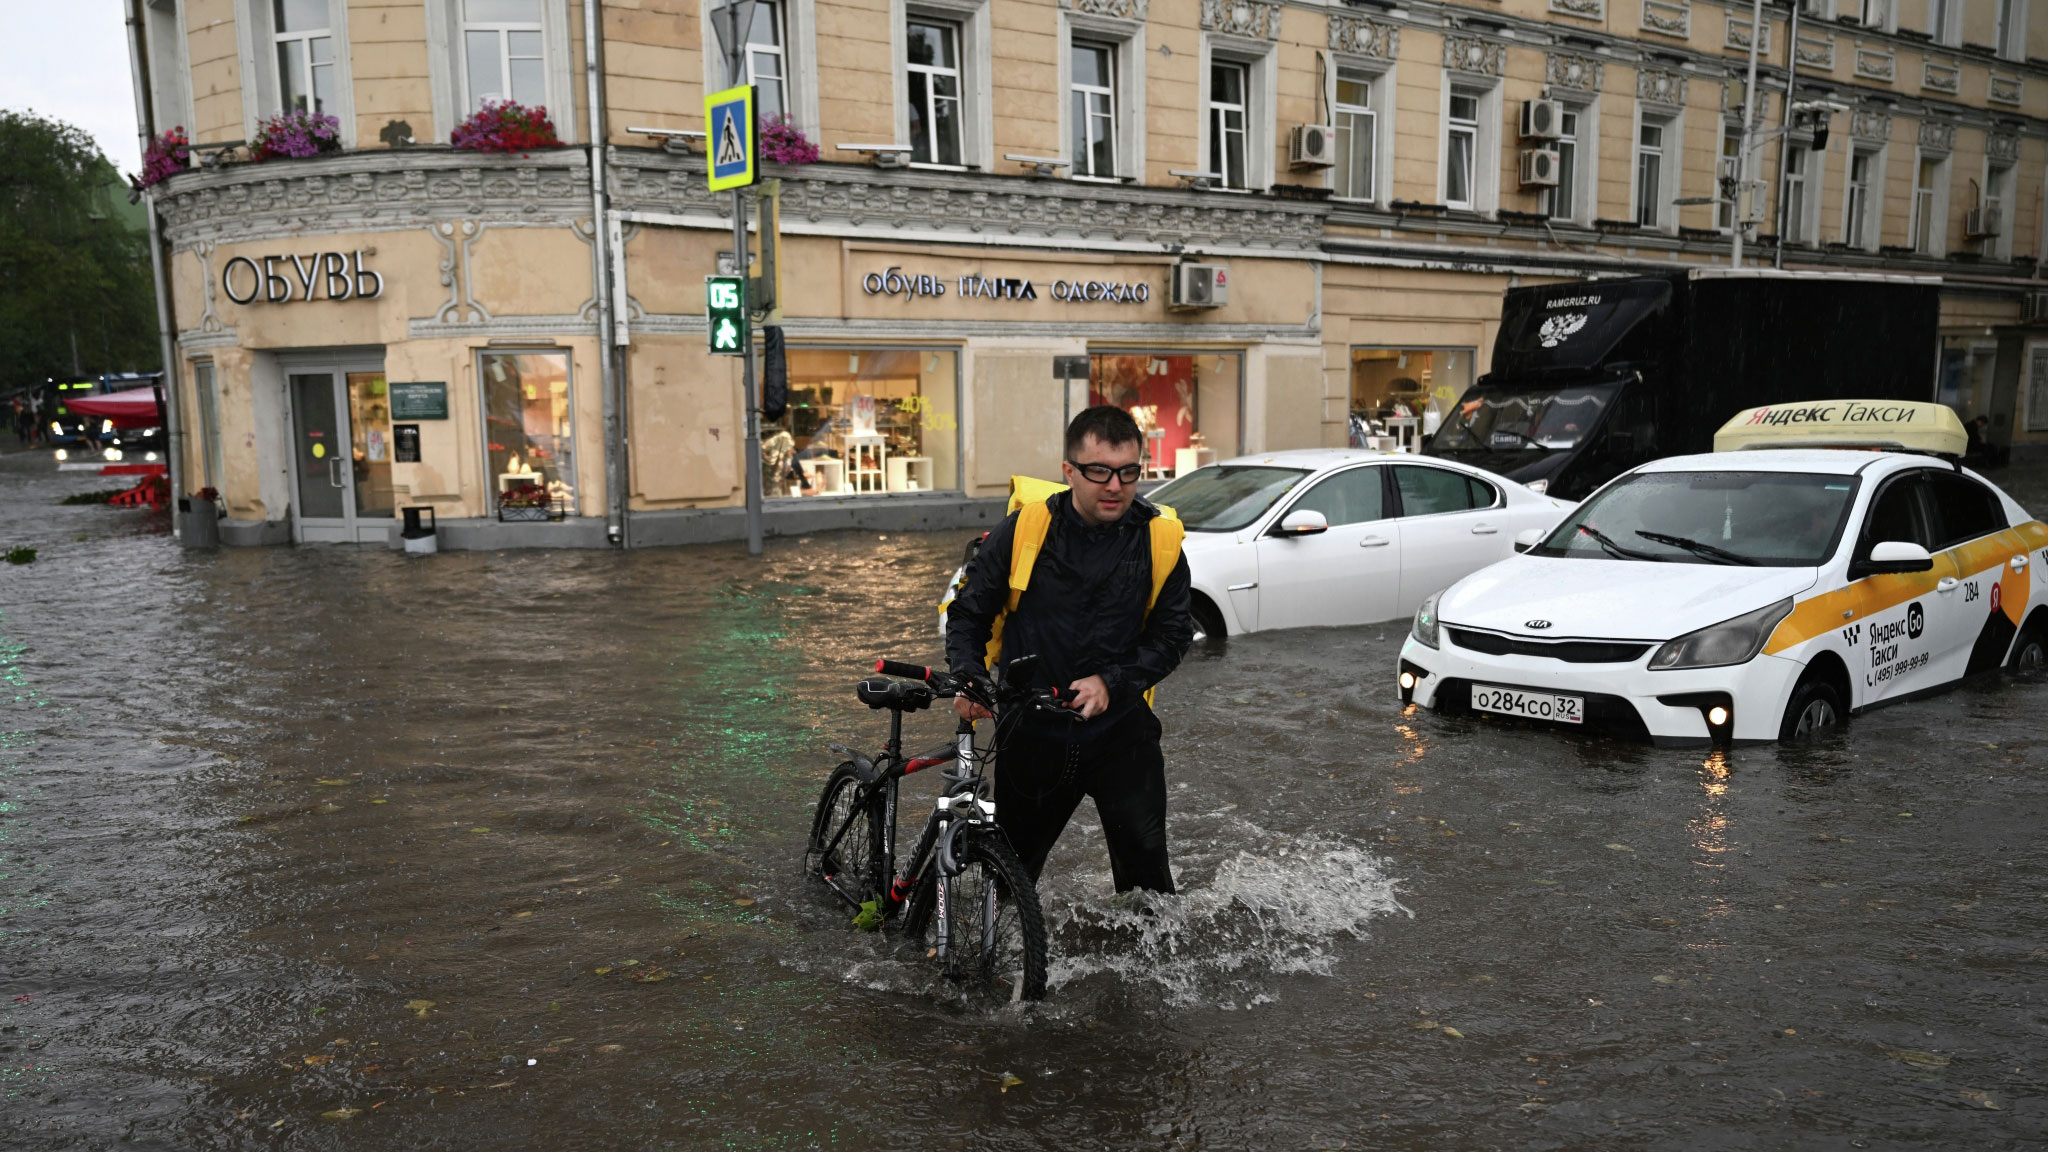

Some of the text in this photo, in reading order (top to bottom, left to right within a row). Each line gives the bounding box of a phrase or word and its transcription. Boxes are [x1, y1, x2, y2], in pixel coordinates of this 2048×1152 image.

[223, 250, 384, 305] ОБУВЬ
[710, 283, 738, 308] 05
[1546, 295, 1601, 309] RAMGRUZ.RU
[895, 396, 933, 413] -40%
[1745, 402, 1915, 426] Яндекс Такси
[1964, 581, 1979, 602] 284
[1527, 620, 1548, 628] KIA
[1870, 610, 1923, 645] Яндекс Go
[1870, 644, 1898, 668] Такси
[1874, 652, 1929, 686] (495) 999-99-99
[1556, 712, 1569, 720] RUS
[1557, 698, 1576, 715] 32
